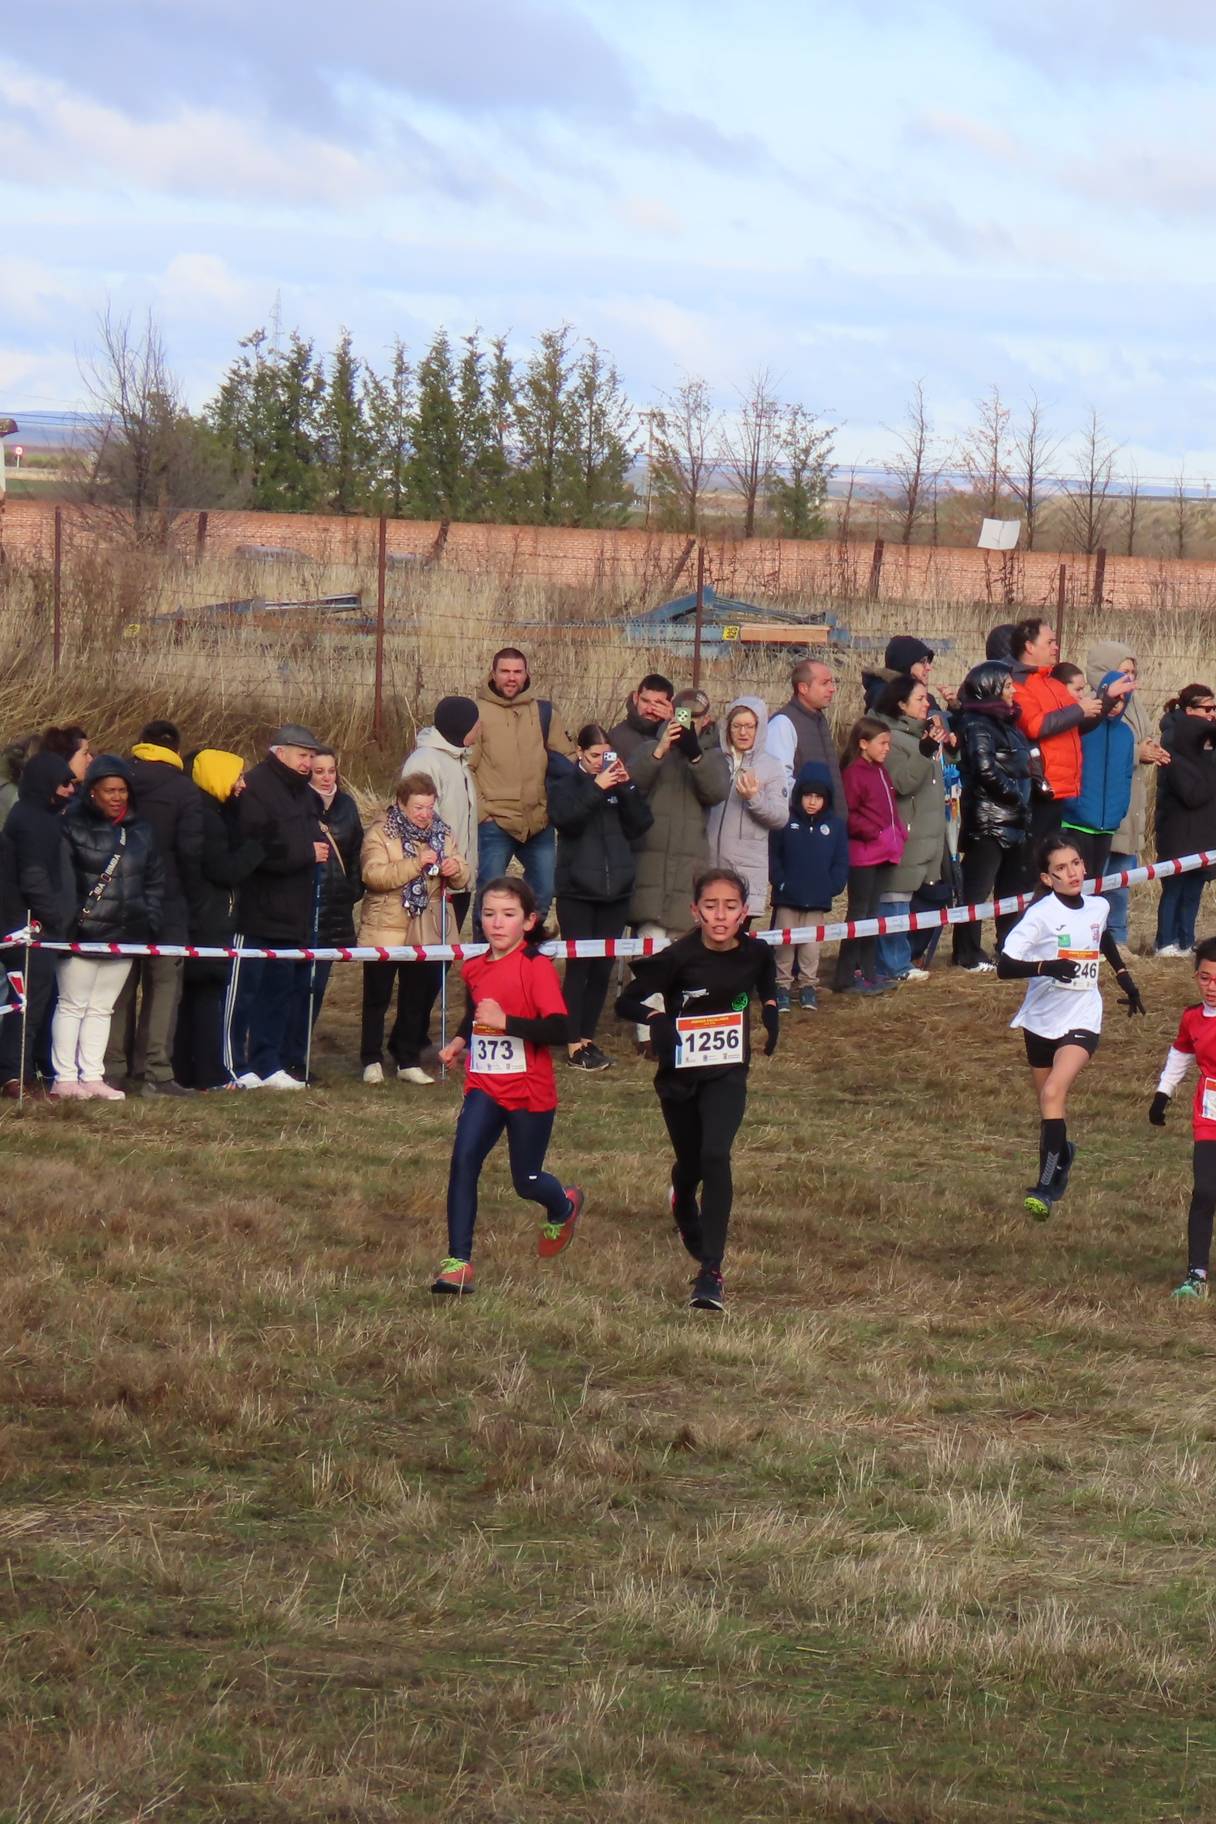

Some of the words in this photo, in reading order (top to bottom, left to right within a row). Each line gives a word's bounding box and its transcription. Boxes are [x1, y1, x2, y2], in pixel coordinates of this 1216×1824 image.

[1072, 961, 1097, 979] 246
[477, 1039, 514, 1060] 373
[685, 1029, 740, 1053] 1256
